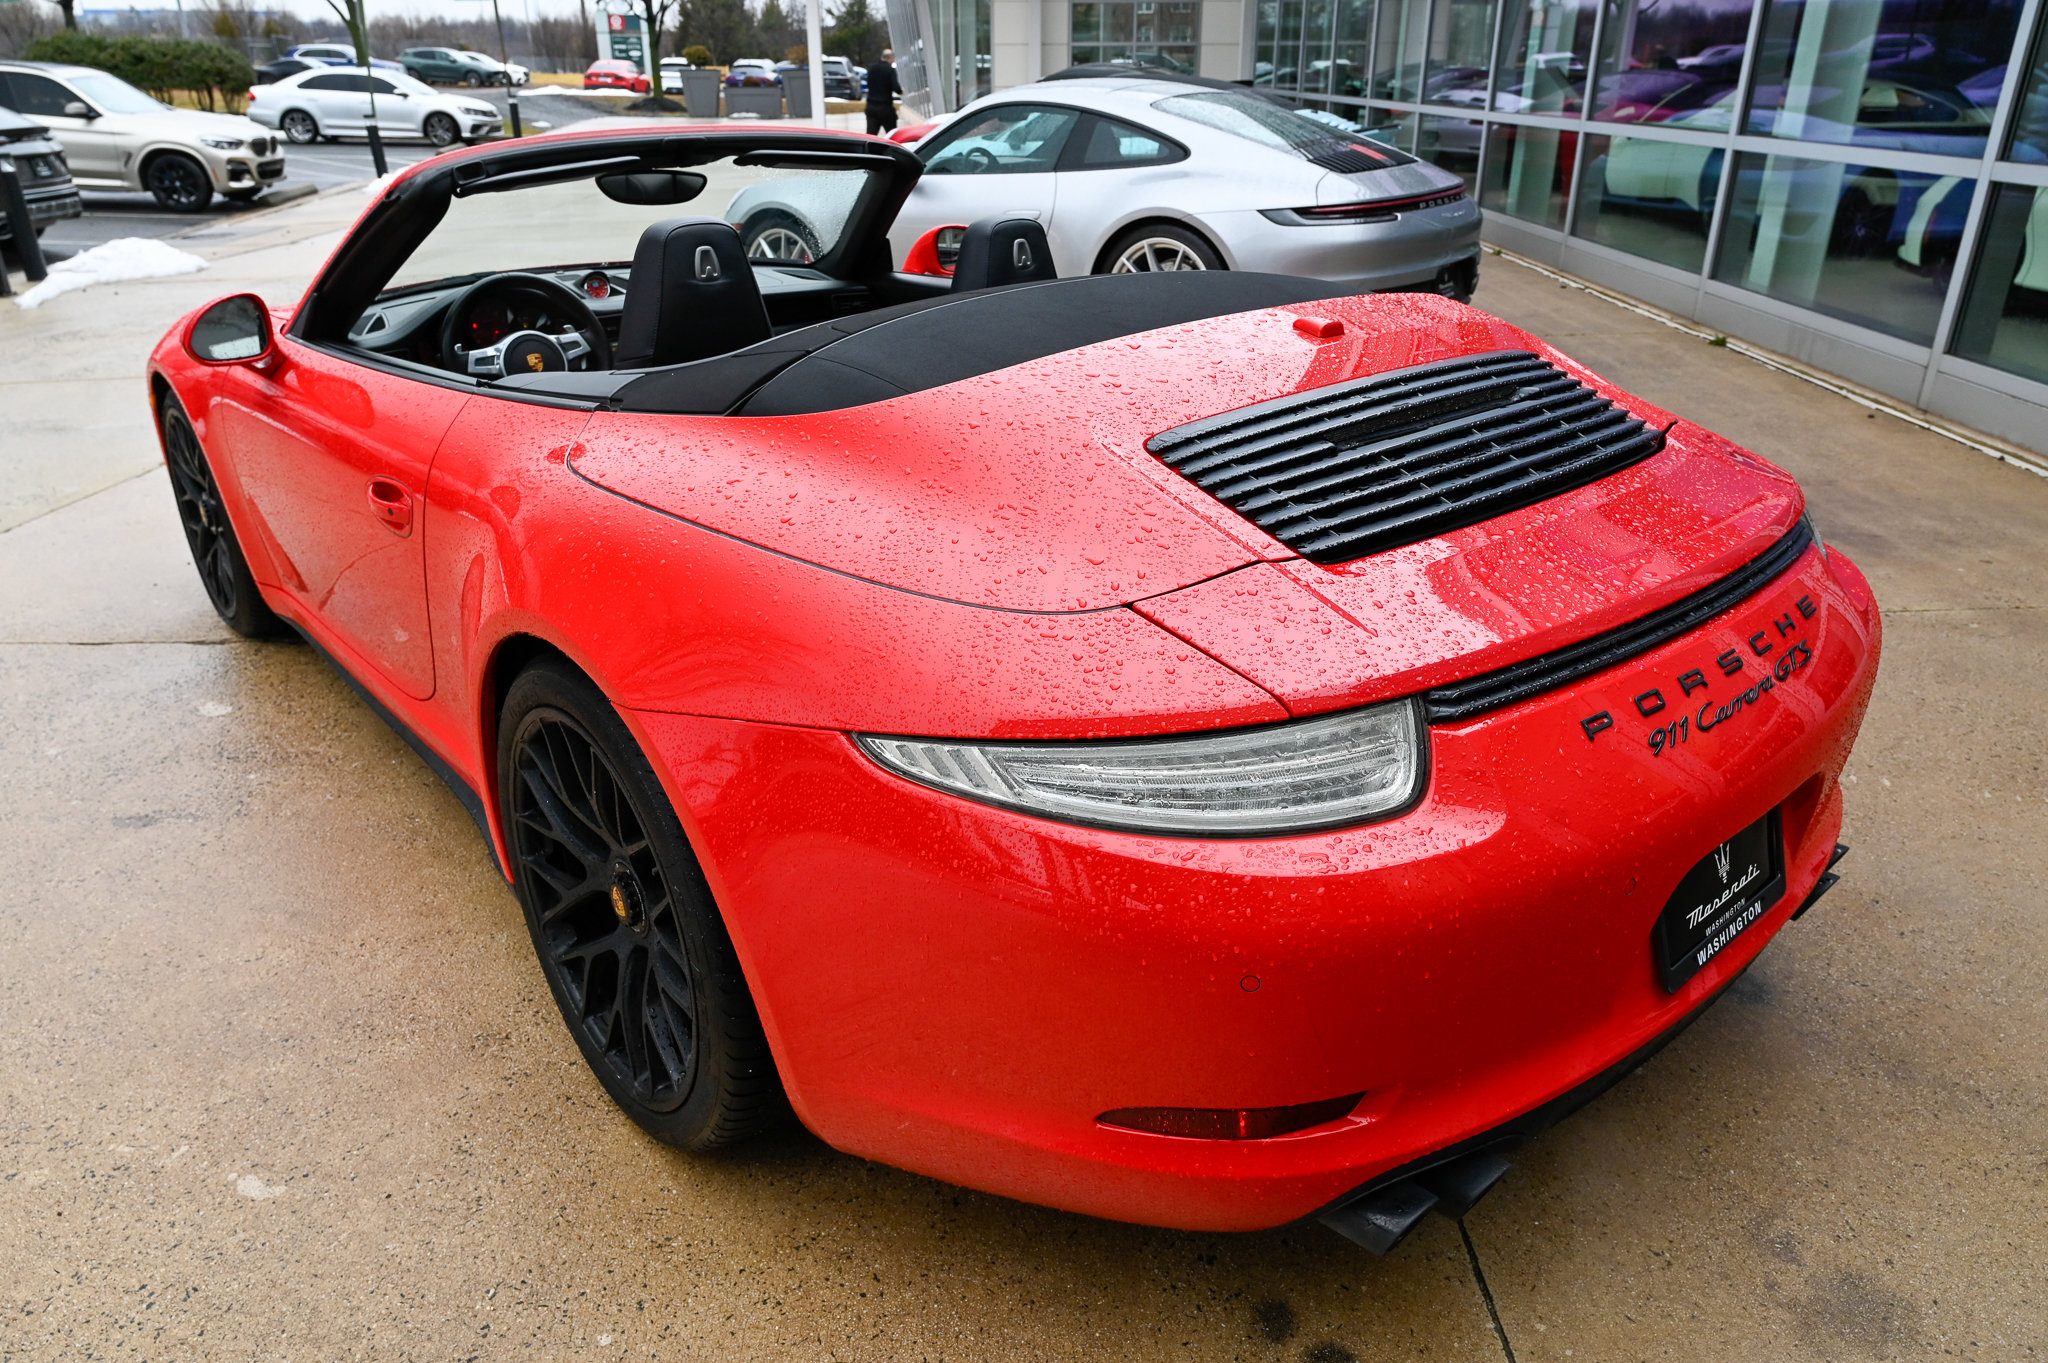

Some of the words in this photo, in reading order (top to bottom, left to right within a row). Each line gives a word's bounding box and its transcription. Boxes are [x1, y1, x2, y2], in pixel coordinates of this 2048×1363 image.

[1580, 595, 1817, 742] PORSCHE
[1649, 716, 1689, 756] 911
[1696, 675, 1776, 732] Carrera
[1774, 639, 1812, 681] GTS
[1686, 864, 1760, 929] Maserati
[1705, 898, 1745, 936] WASHINGTON
[1697, 901, 1762, 966] WASHINGTON
